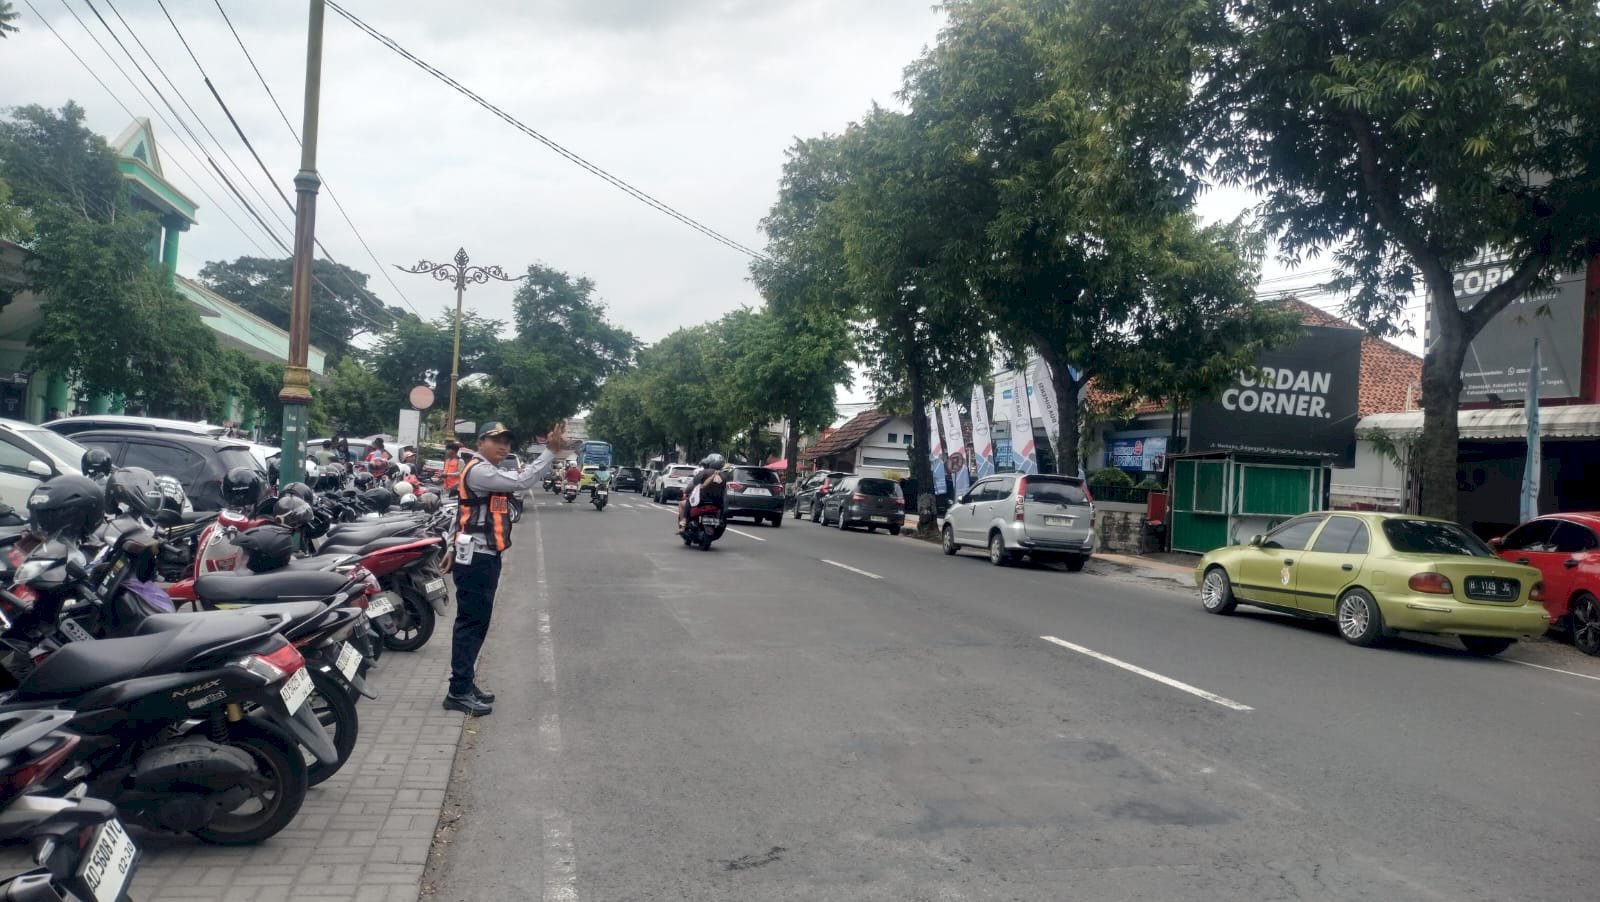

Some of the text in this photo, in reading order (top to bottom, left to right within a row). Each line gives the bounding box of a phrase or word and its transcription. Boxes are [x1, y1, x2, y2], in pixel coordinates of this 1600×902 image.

[1238, 365, 1331, 394] ORDAN
[1221, 388, 1331, 418] CORNER.
[92, 837, 114, 877] 5608
[84, 864, 102, 894] AD
